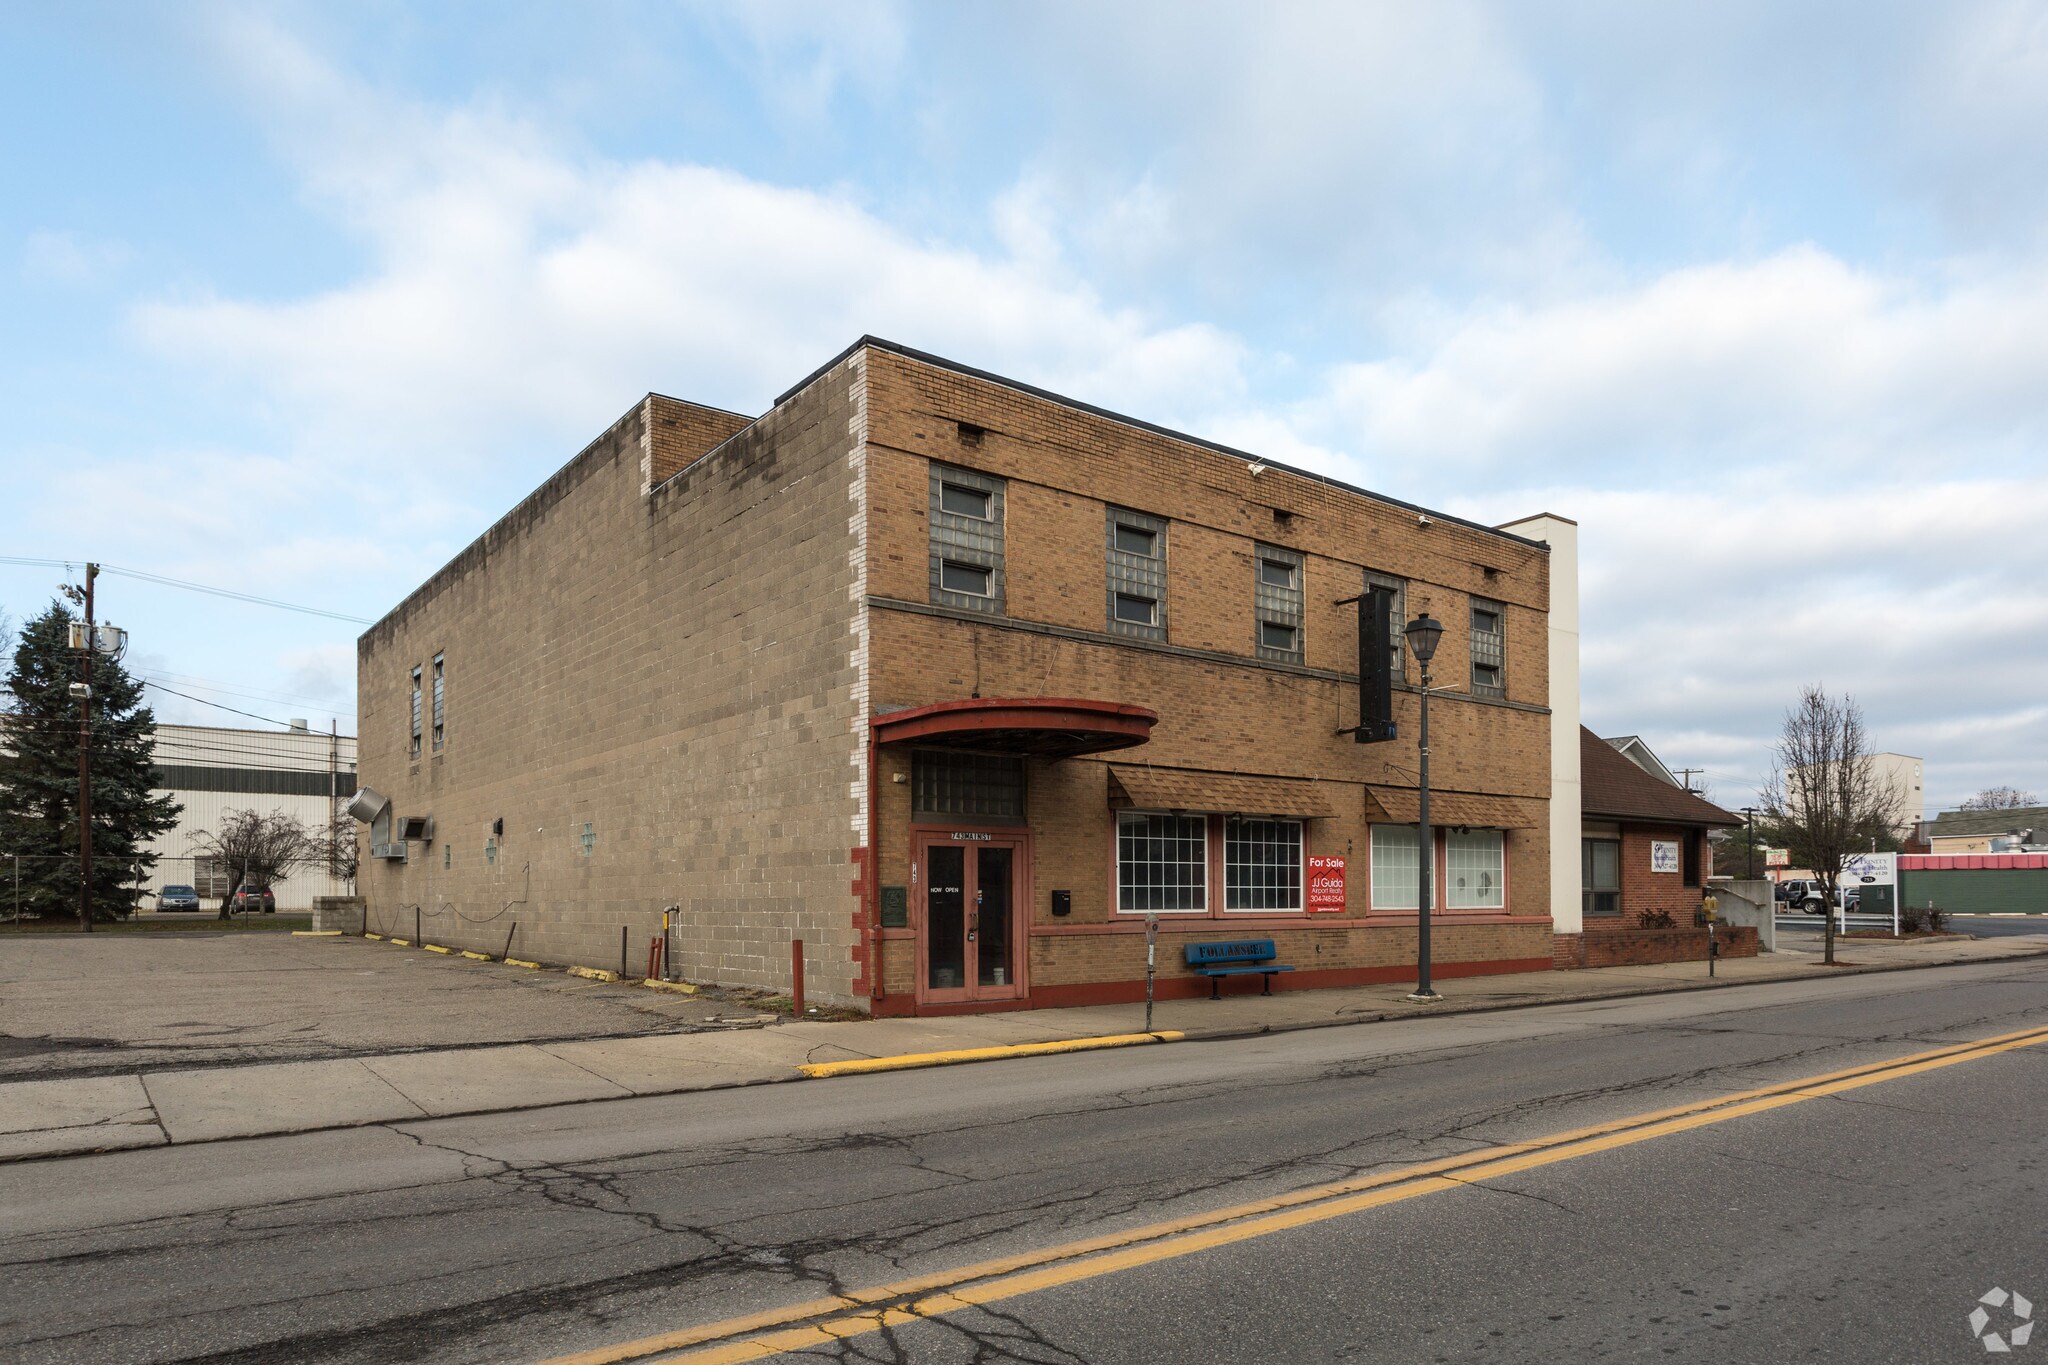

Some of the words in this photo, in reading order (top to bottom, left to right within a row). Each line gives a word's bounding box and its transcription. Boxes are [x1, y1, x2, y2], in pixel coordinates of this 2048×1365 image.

[1310, 858, 1324, 867] For
[1326, 858, 1344, 868] Sale
[1312, 878, 1320, 888] JJ
[1321, 878, 1343, 888] Guida
[1310, 895, 1345, 903] 304-748-2543
[1199, 943, 1267, 958] FOLLANSBEE
